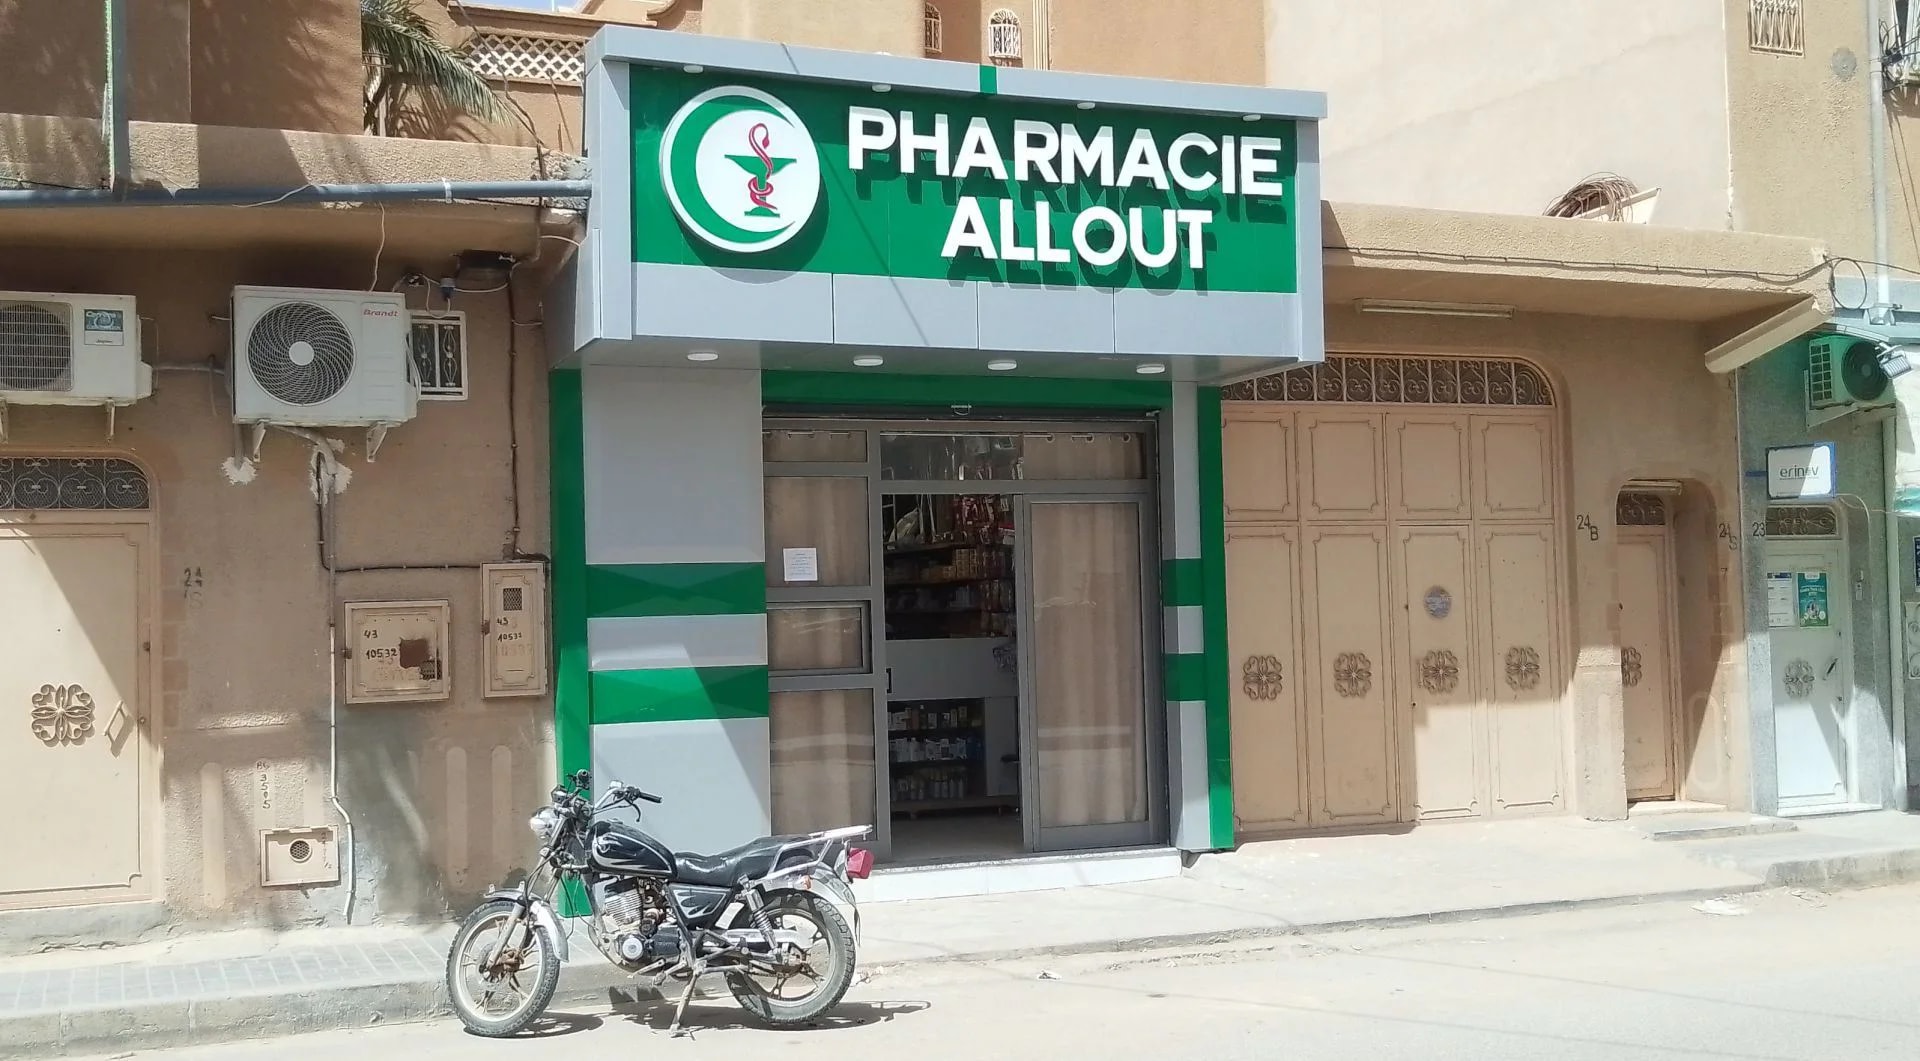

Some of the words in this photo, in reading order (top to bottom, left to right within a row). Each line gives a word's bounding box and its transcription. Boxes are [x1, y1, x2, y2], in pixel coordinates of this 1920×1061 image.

[848, 105, 1284, 196] PHARMACIE
[940, 195, 1213, 269] ALLOUT
[363, 309, 398, 317] Brandt
[1752, 521, 1766, 537] 23
[364, 629, 378, 639] 43
[366, 647, 398, 660] 10532
